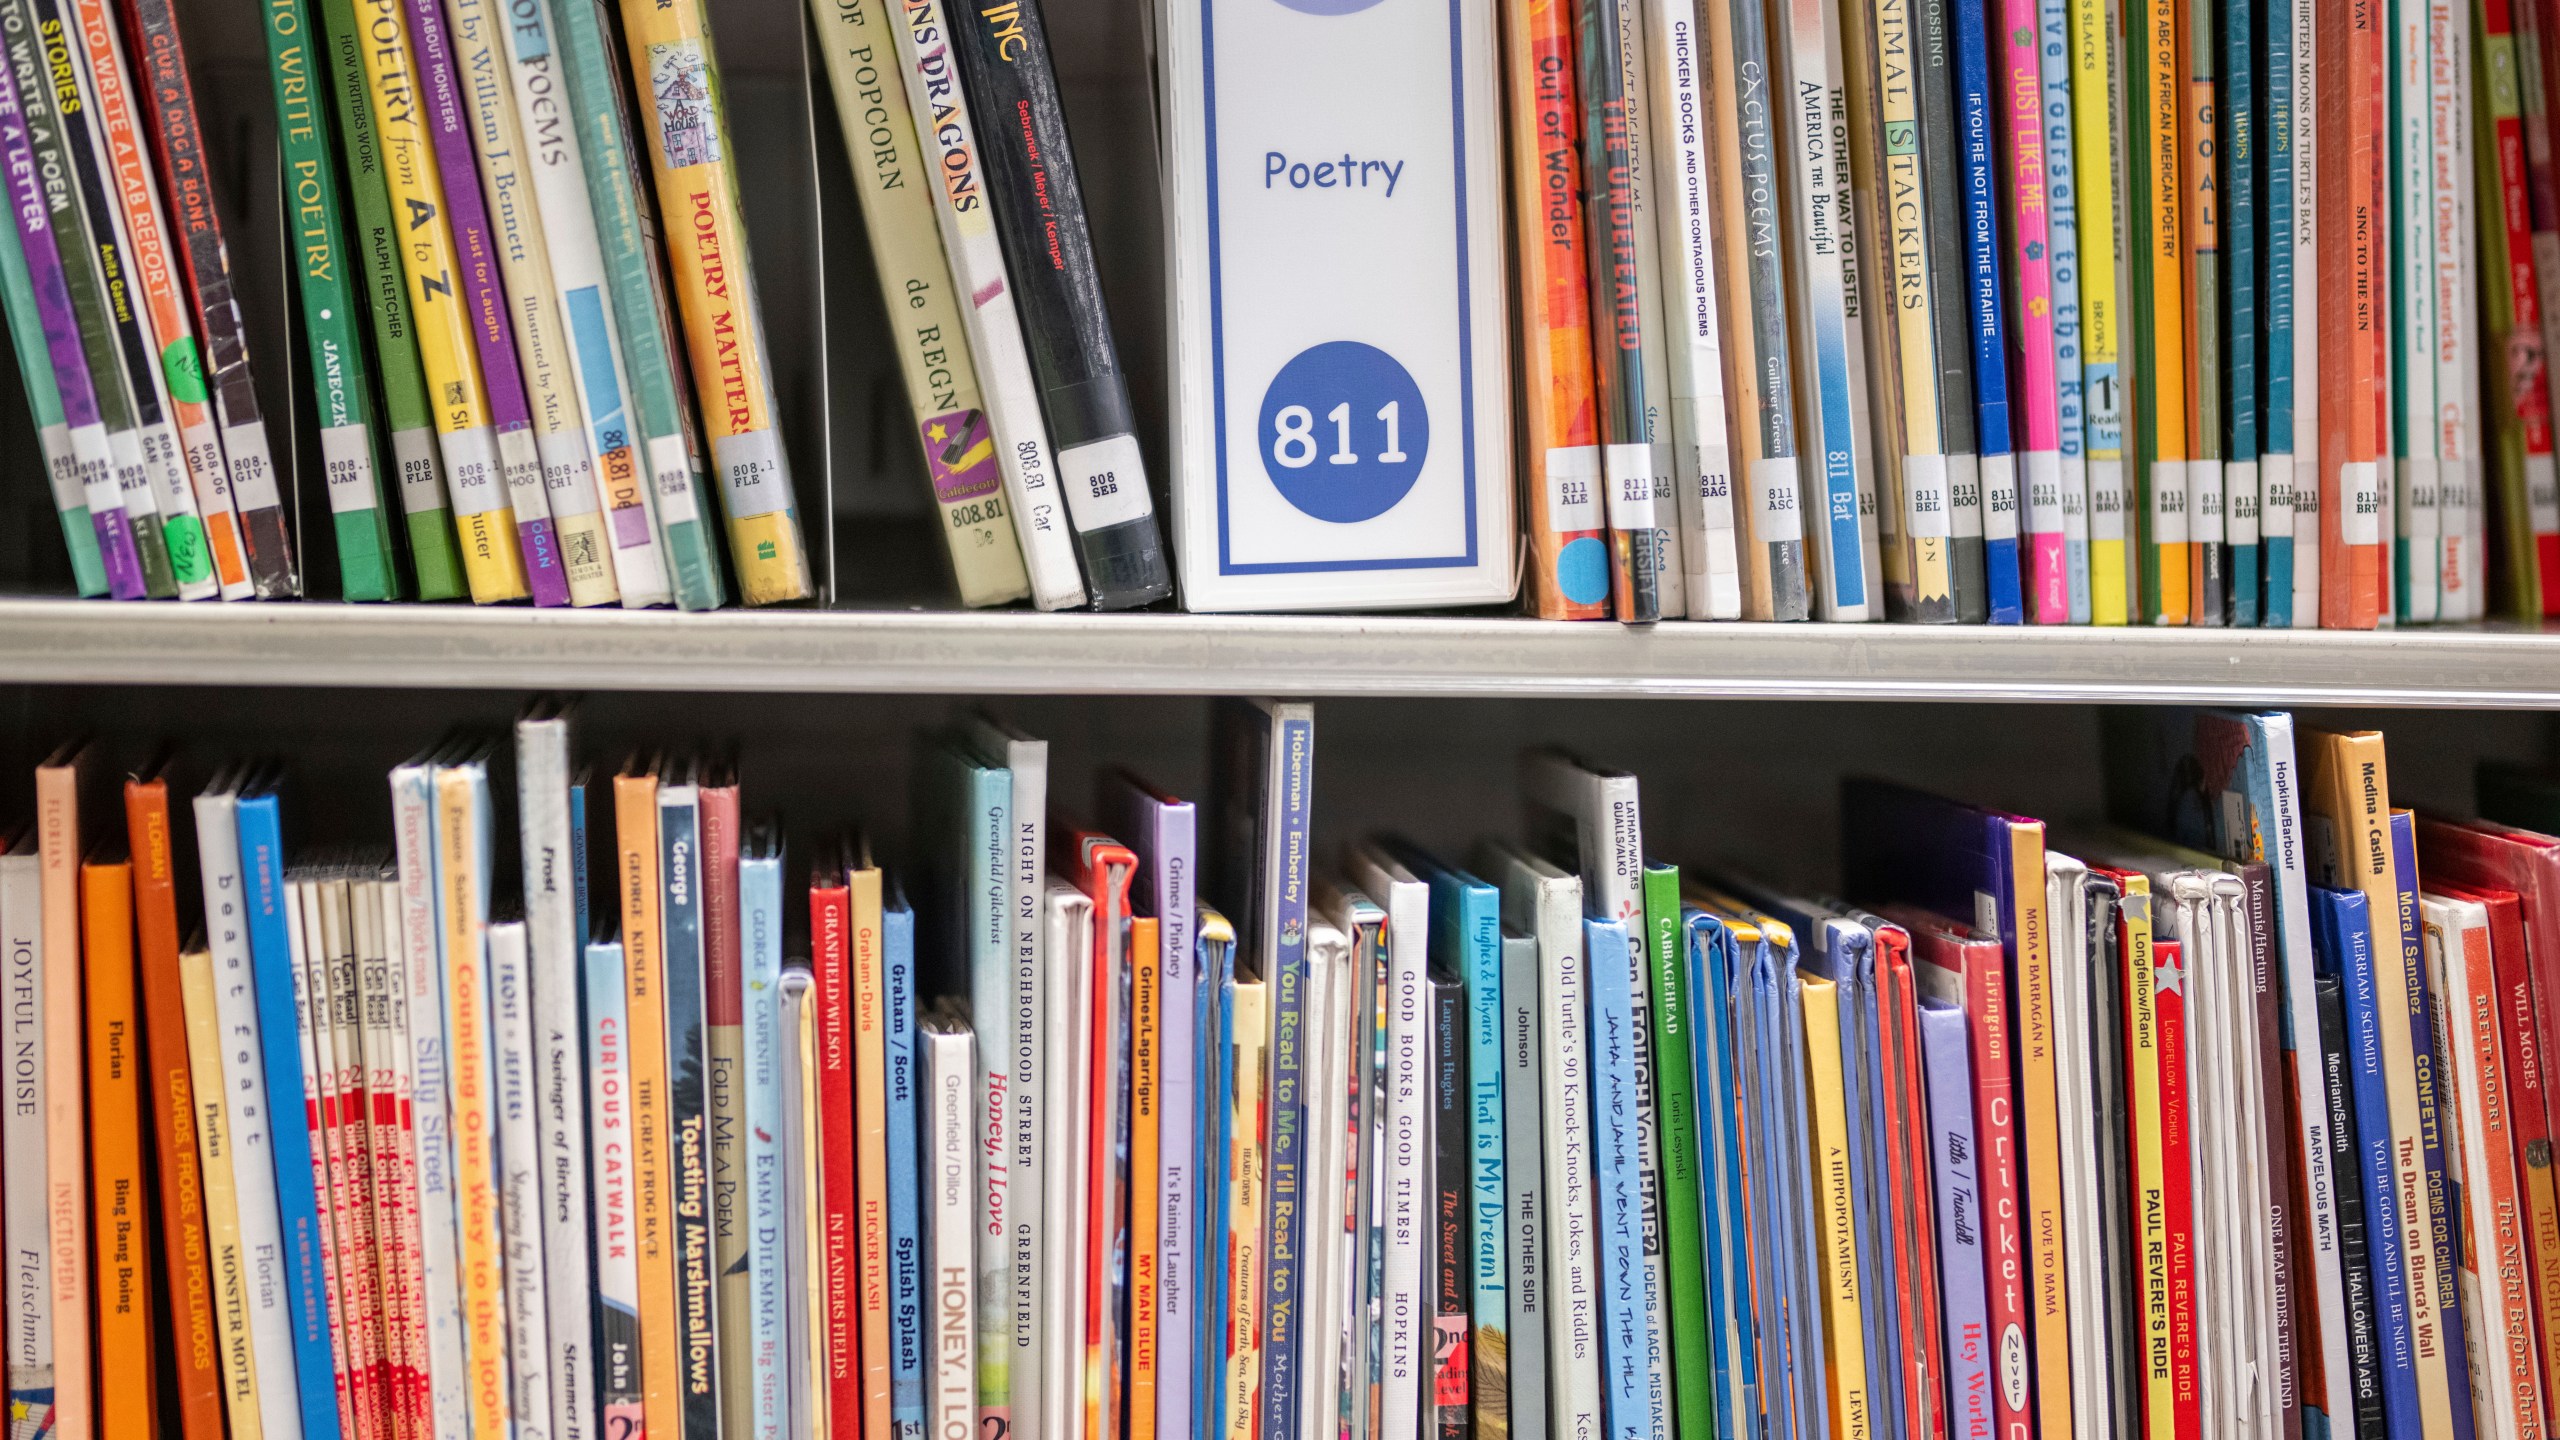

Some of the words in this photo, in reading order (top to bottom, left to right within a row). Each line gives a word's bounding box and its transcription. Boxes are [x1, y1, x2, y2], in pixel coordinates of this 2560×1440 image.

[980, 2, 1026, 61] INC
[1674, 21, 1693, 88] CHICKEN
[41, 20, 80, 114] STORIES
[369, 0, 416, 124] POETRY
[1539, 57, 1565, 102] Out
[524, 55, 568, 167] POEMS
[849, 47, 903, 190] POPCORN
[1678, 93, 1696, 144] SOCKS
[1740, 61, 1768, 161] CACTUS
[1801, 80, 1824, 162] AMERICA
[1830, 88, 1844, 120] THE
[2012, 68, 2036, 123] JUST
[919, 55, 980, 213] DRAGONS
[1544, 111, 1567, 139] of
[1602, 95, 1628, 152] THE
[1970, 108, 1983, 162] YOU'RE
[385, 135, 419, 187] from
[1266, 151, 1404, 198] Poetry
[1686, 150, 1697, 172] AND
[1811, 167, 1825, 189] THE
[1832, 125, 1850, 184] OTHER
[2017, 130, 2039, 176] LIKE
[1016, 101, 1040, 161] Sebranek
[1030, 173, 1049, 210] Meyer
[1042, 221, 1066, 270] Kemper
[1548, 151, 1571, 250] Wonder
[1686, 177, 1700, 216] OTHER
[1837, 189, 1852, 225] WAY
[1972, 167, 1985, 197] NOT
[2021, 183, 2043, 215] ME
[405, 199, 436, 230] A
[1750, 173, 1775, 259] POEMS
[1810, 193, 1835, 255] Beautiful
[1889, 129, 1924, 310] STACKERS
[1974, 201, 1988, 242] FROM
[2356, 206, 2368, 240] SING
[99, 244, 120, 278] Anita
[371, 227, 391, 270] RALPH
[413, 242, 434, 262] to
[689, 192, 727, 299] POETRY
[1606, 166, 1641, 351] UNDEFEATED
[1690, 219, 1705, 292] CONTAGIOUS
[1839, 230, 1854, 252] TO
[1976, 246, 1990, 275] THE
[2357, 245, 2368, 265] TO
[106, 280, 131, 323] Ganeri
[378, 274, 403, 338] FLETCHER
[420, 274, 451, 301] Z
[1842, 259, 1858, 318] LISTEN
[1978, 278, 1993, 336] PRAIRIE
[2356, 268, 2369, 298] THE
[1694, 296, 1709, 337] POEMS
[2357, 303, 2369, 331] SUN
[1273, 400, 1408, 469] 811
[734, 478, 760, 488] FLE
[1016, 441, 1044, 491] 808.81
[1031, 505, 1054, 531] Car
[1090, 473, 1115, 484] 808
[1092, 484, 1118, 495] SEB
[1561, 483, 1586, 495] 811
[1828, 450, 1848, 479] 811
[1561, 496, 1588, 505] ALE
[1832, 492, 1853, 521] Bat
[1916, 490, 1939, 501] 811
[1916, 502, 1940, 512] BEL
[2357, 493, 2377, 502] 811
[1288, 730, 1305, 811] Hoberman
[2360, 762, 2379, 813] Medina
[2275, 761, 2297, 870] Hopkins/Barbour
[1020, 823, 1035, 884] NIGHT
[1283, 831, 1302, 903] Emberley
[2369, 828, 2387, 875] Casilla
[1020, 895, 1033, 919] ON
[2251, 879, 2271, 994] Mannis/Hartung
[13, 938, 33, 1033] JOYFUL
[824, 904, 842, 1070] GRANFIELD/WILSON
[1279, 961, 1300, 1004] You
[1400, 970, 1415, 1022] GOOD
[1559, 956, 1577, 989] Old
[1660, 917, 1679, 1034] CABBAGEHEAD
[2131, 932, 2152, 1048] Longfellow/Rand
[1018, 932, 1034, 1084] NEIGHBORHOOD
[1561, 990, 1579, 1053] Turtle's
[2513, 982, 2529, 1019] WILL
[1138, 966, 1154, 1116] Grimes/Lagarrigue
[1278, 1010, 1299, 1071] Read
[1516, 1007, 1531, 1068] Johnson
[2516, 1025, 2537, 1089] MOSES
[15, 1039, 36, 1116] NOISE
[601, 1017, 621, 1129] CURIOUS
[1278, 1078, 1296, 1103] to
[1397, 1034, 1414, 1105] BOOKS,
[1563, 1058, 1581, 1078] 90
[985, 1072, 1008, 1154] Honey,
[1476, 1071, 1500, 1126] That
[2326, 1052, 2348, 1153] Merriam/Smith
[2415, 1054, 2438, 1150] CONFETTI
[1018, 1095, 1032, 1167] STREET
[1275, 1109, 1296, 1154] Me,
[1397, 1116, 1413, 1168] GOOD
[1479, 1133, 1497, 1148] is
[1562, 1083, 1585, 1206] Knock-Knocks,
[1829, 1147, 1841, 1157] A
[2397, 1136, 2415, 1164] The
[680, 1116, 706, 1217] Toasting
[989, 1163, 1007, 1175] I
[1166, 1166, 1180, 1187] It's
[1275, 1163, 1295, 1193] I'll
[1475, 1157, 1501, 1196] My
[2308, 1125, 2327, 1208] MARVELOUS
[2427, 1170, 2445, 1213] POEMS
[112, 1179, 130, 1215] Bing
[604, 1142, 627, 1260] CATWALK
[988, 1177, 1007, 1236] Love
[1164, 1192, 1180, 1242] Raining
[1395, 1179, 1411, 1245] TIMES!
[1520, 1191, 1534, 1221] THE
[2146, 1189, 2161, 1235] PAUL
[2400, 1169, 2419, 1223] Dream
[114, 1220, 132, 1260] Bang
[1273, 1199, 1294, 1261] Read
[1476, 1202, 1504, 1291] Dream!
[1521, 1225, 1535, 1275] OTHER
[1567, 1211, 1586, 1261] Jokes,
[1830, 1160, 1853, 1302] HIPPOPOTAMUSN'T
[2039, 1210, 2054, 1247] LOVE
[2317, 1212, 2332, 1251] MATH
[2405, 1228, 2421, 1250] on
[2432, 1216, 2449, 1241] FOR
[1163, 1247, 1180, 1315] Laughter
[1273, 1267, 1292, 1292] to
[1570, 1266, 1588, 1295] and
[2042, 1251, 2055, 1267] TO
[2435, 1244, 2455, 1309] CHILDREN
[116, 1266, 135, 1313] Boing
[684, 1224, 711, 1394] Marshmallows
[1017, 1224, 1031, 1348] GREENFIELD
[1522, 1278, 1536, 1313] SIDE
[2043, 1272, 2059, 1316] MAMÁ
[2147, 1241, 2165, 1331] REVERE'S
[2409, 1254, 2432, 1321] Blanca's
[1272, 1300, 1291, 1342] You
[1393, 1292, 1409, 1379] HOPKINS
[1571, 1299, 1591, 1358] Riddles
[2349, 1272, 2371, 1363] HALLOWEEN
[2417, 1324, 2434, 1358] Wall
[2151, 1336, 2168, 1379] RIDE
[2357, 1366, 2373, 1398] ABC
